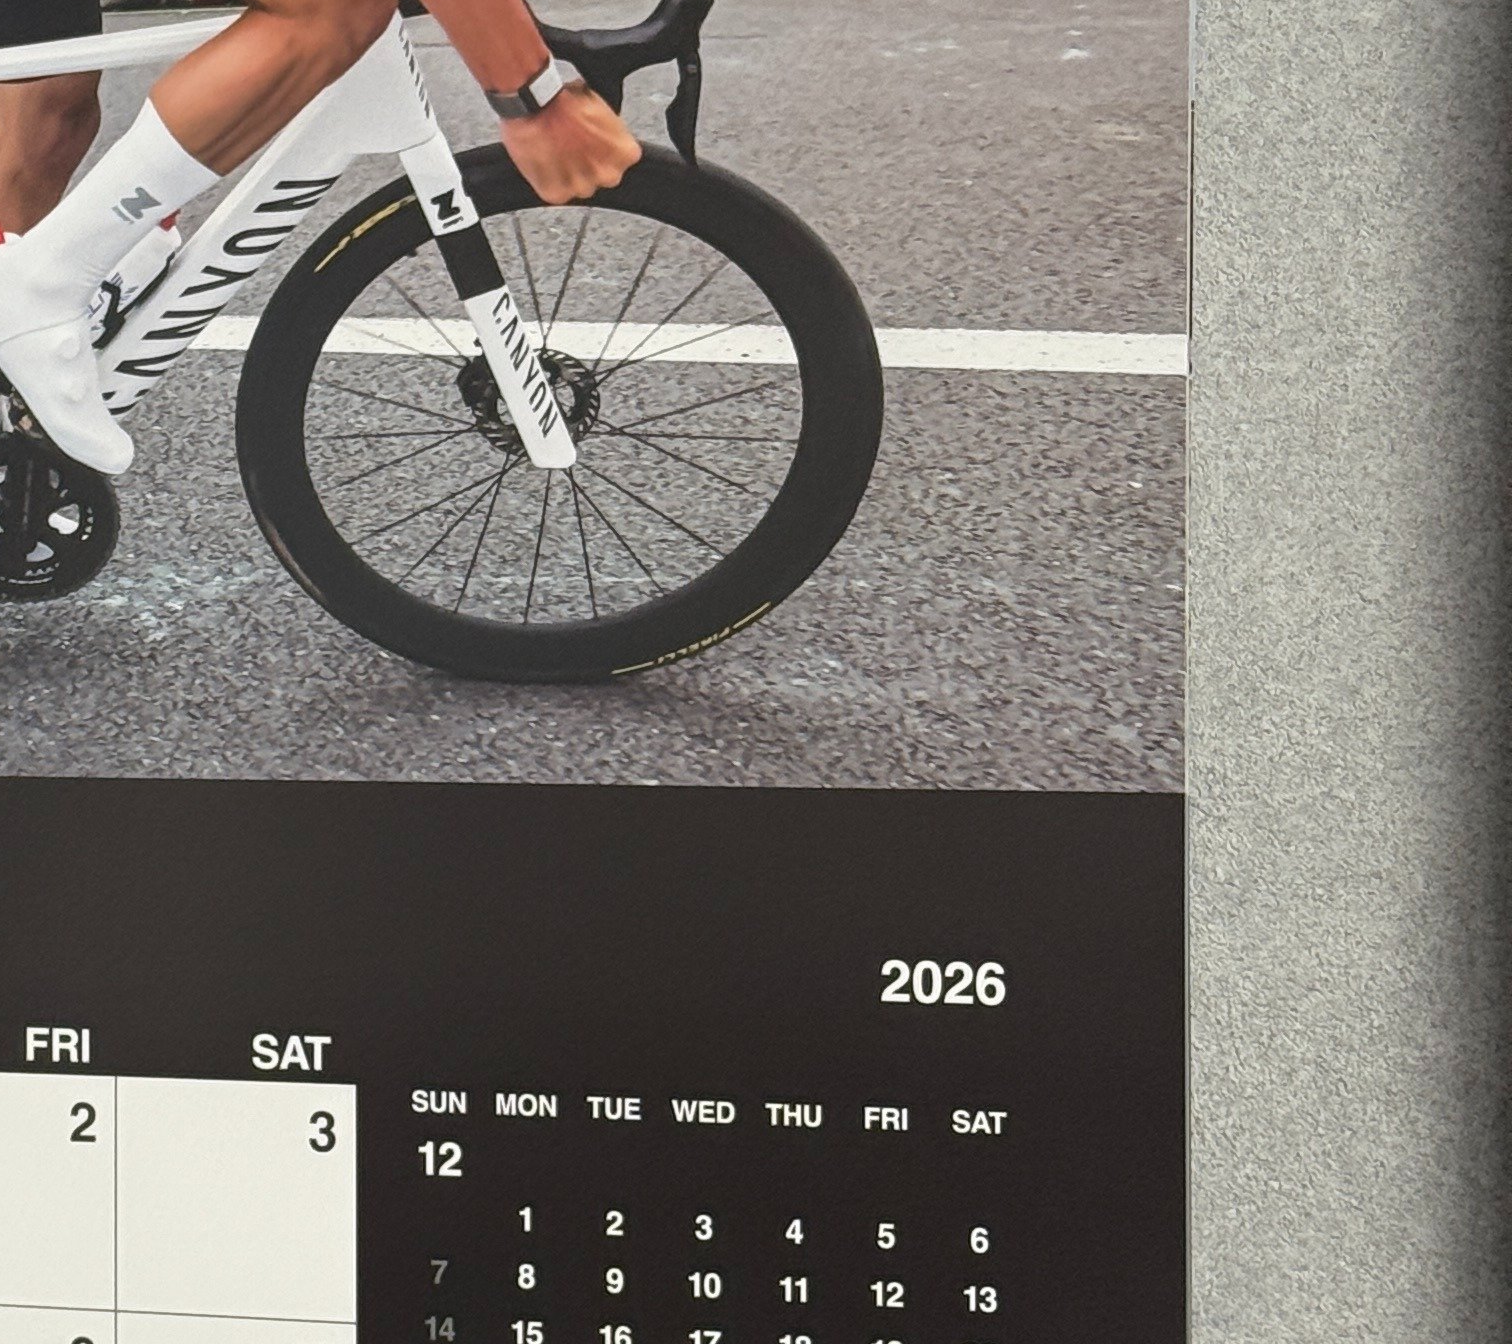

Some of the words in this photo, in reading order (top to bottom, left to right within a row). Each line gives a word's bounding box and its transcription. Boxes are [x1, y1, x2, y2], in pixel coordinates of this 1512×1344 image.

[491, 291, 559, 439] CANYON
[880, 958, 1007, 1007] 2026
[26, 1027, 91, 1064] FRI
[251, 1034, 332, 1072] SAT
[69, 1101, 98, 1144] 2
[308, 1109, 337, 1154] 3
[410, 1088, 468, 1115] SUN
[495, 1092, 559, 1118] MON
[585, 1095, 643, 1121] TUE
[670, 1098, 737, 1125] WED
[764, 1102, 824, 1129] THU
[863, 1105, 909, 1132] FRI
[951, 1108, 1009, 1135] SAT
[417, 1140, 464, 1178] 12
[518, 1206, 533, 1233] 1
[605, 1209, 626, 1237] 2
[694, 1213, 714, 1242] 3
[784, 1218, 805, 1245] 4
[876, 1222, 897, 1250] 5
[969, 1226, 991, 1255] 6
